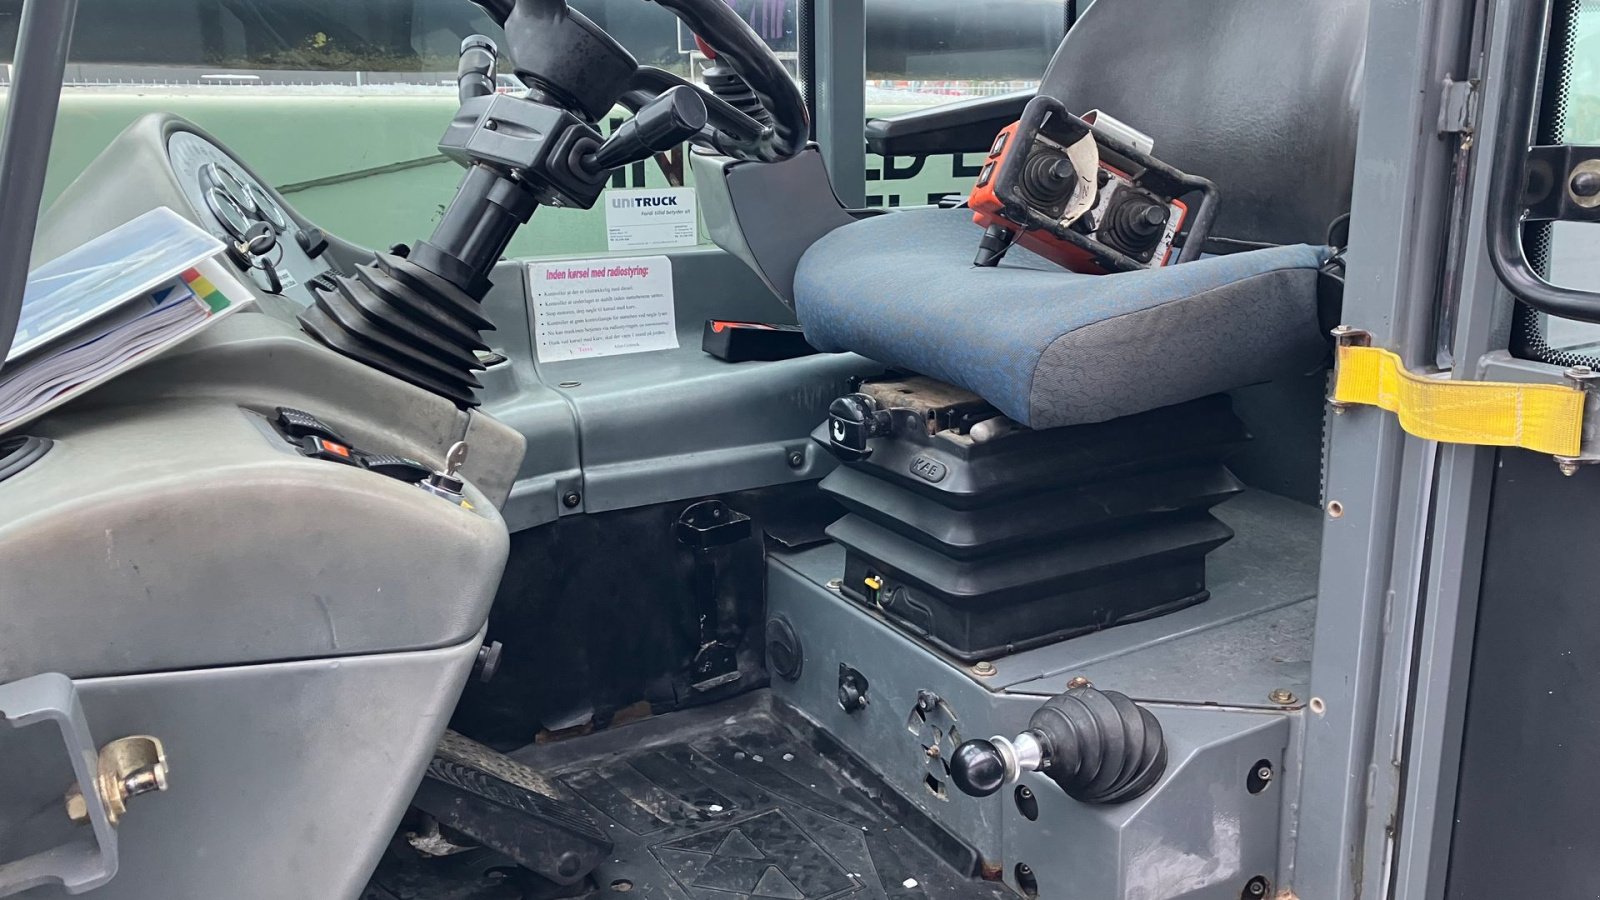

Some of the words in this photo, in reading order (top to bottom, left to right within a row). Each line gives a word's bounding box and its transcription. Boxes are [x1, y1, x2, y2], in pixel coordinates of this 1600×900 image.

[612, 196, 678, 208] uniTRUCK
[546, 269, 565, 280] Inden
[591, 267, 605, 278] med
[913, 458, 938, 476] KAB
